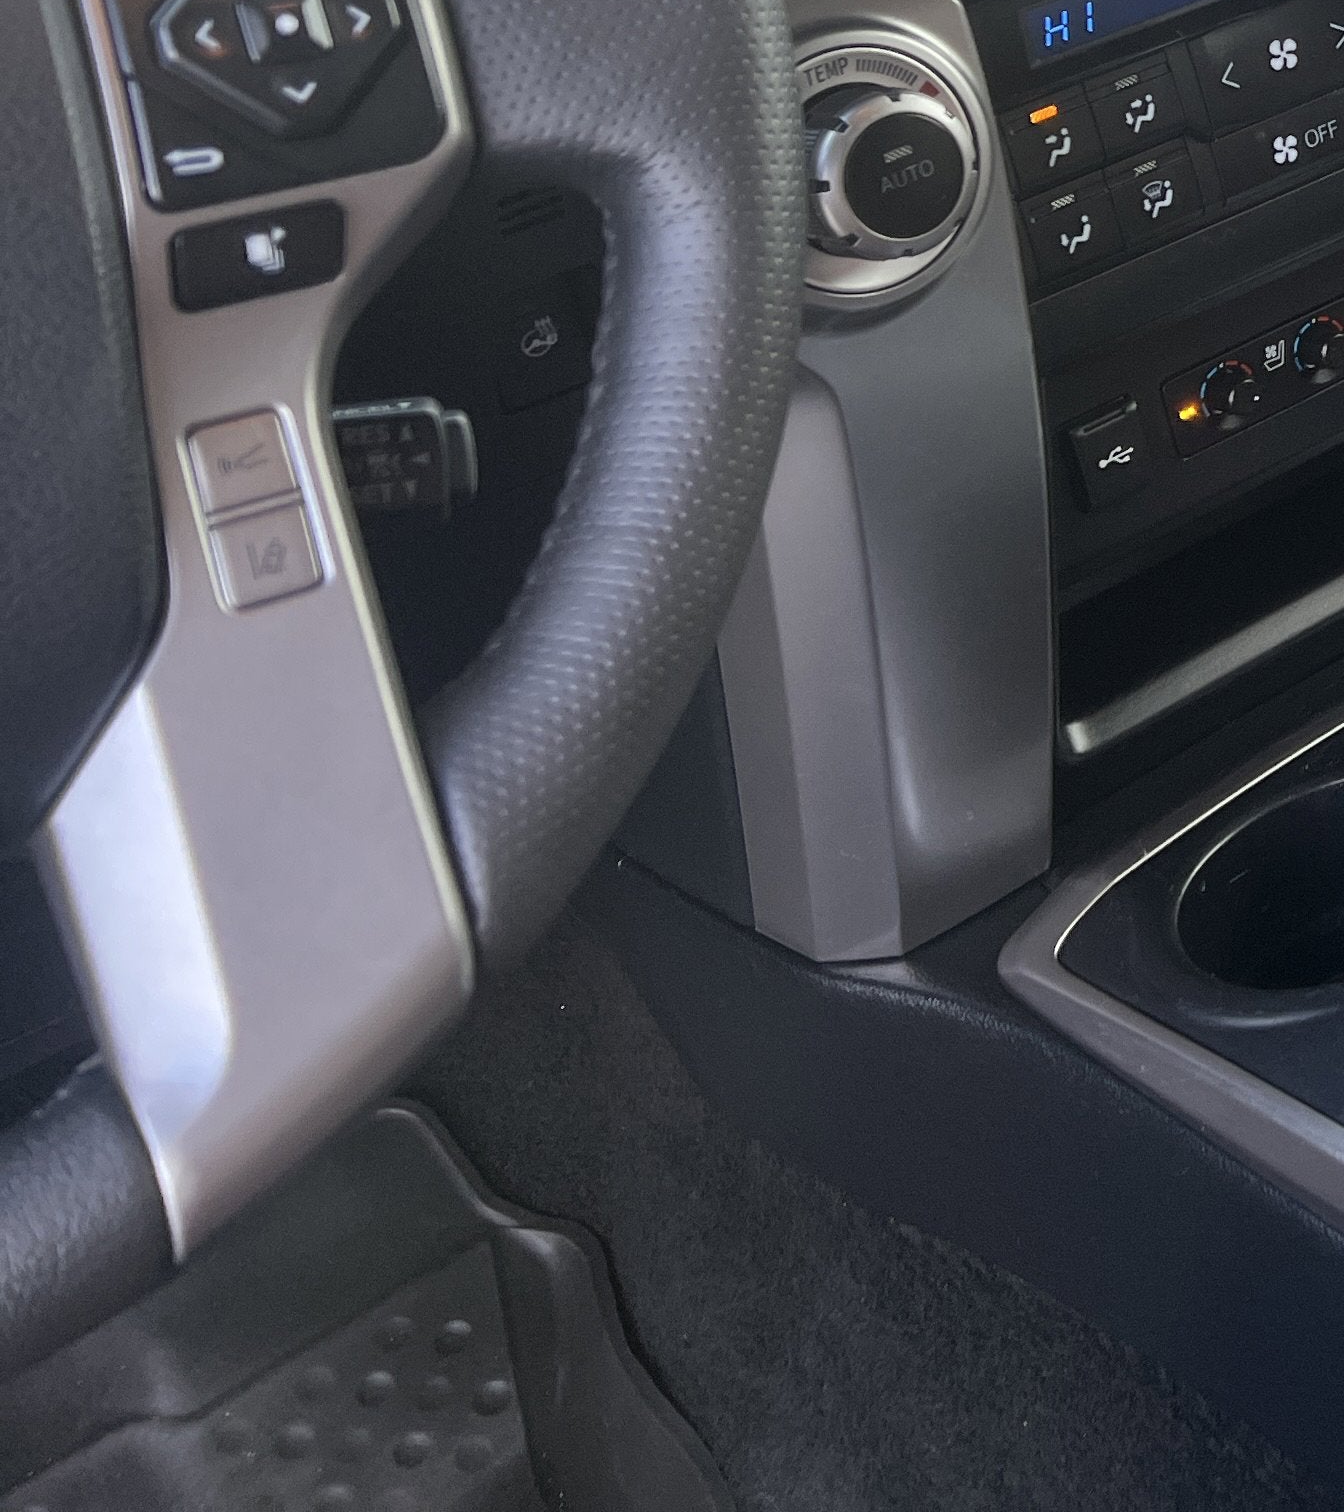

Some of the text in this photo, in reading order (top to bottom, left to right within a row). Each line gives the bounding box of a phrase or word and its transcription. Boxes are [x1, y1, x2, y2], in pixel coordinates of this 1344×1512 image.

[1043, 2, 1094, 48] HI
[804, 57, 848, 86] TEMP
[1304, 120, 1338, 149] OFF
[880, 159, 934, 193] AUTO
